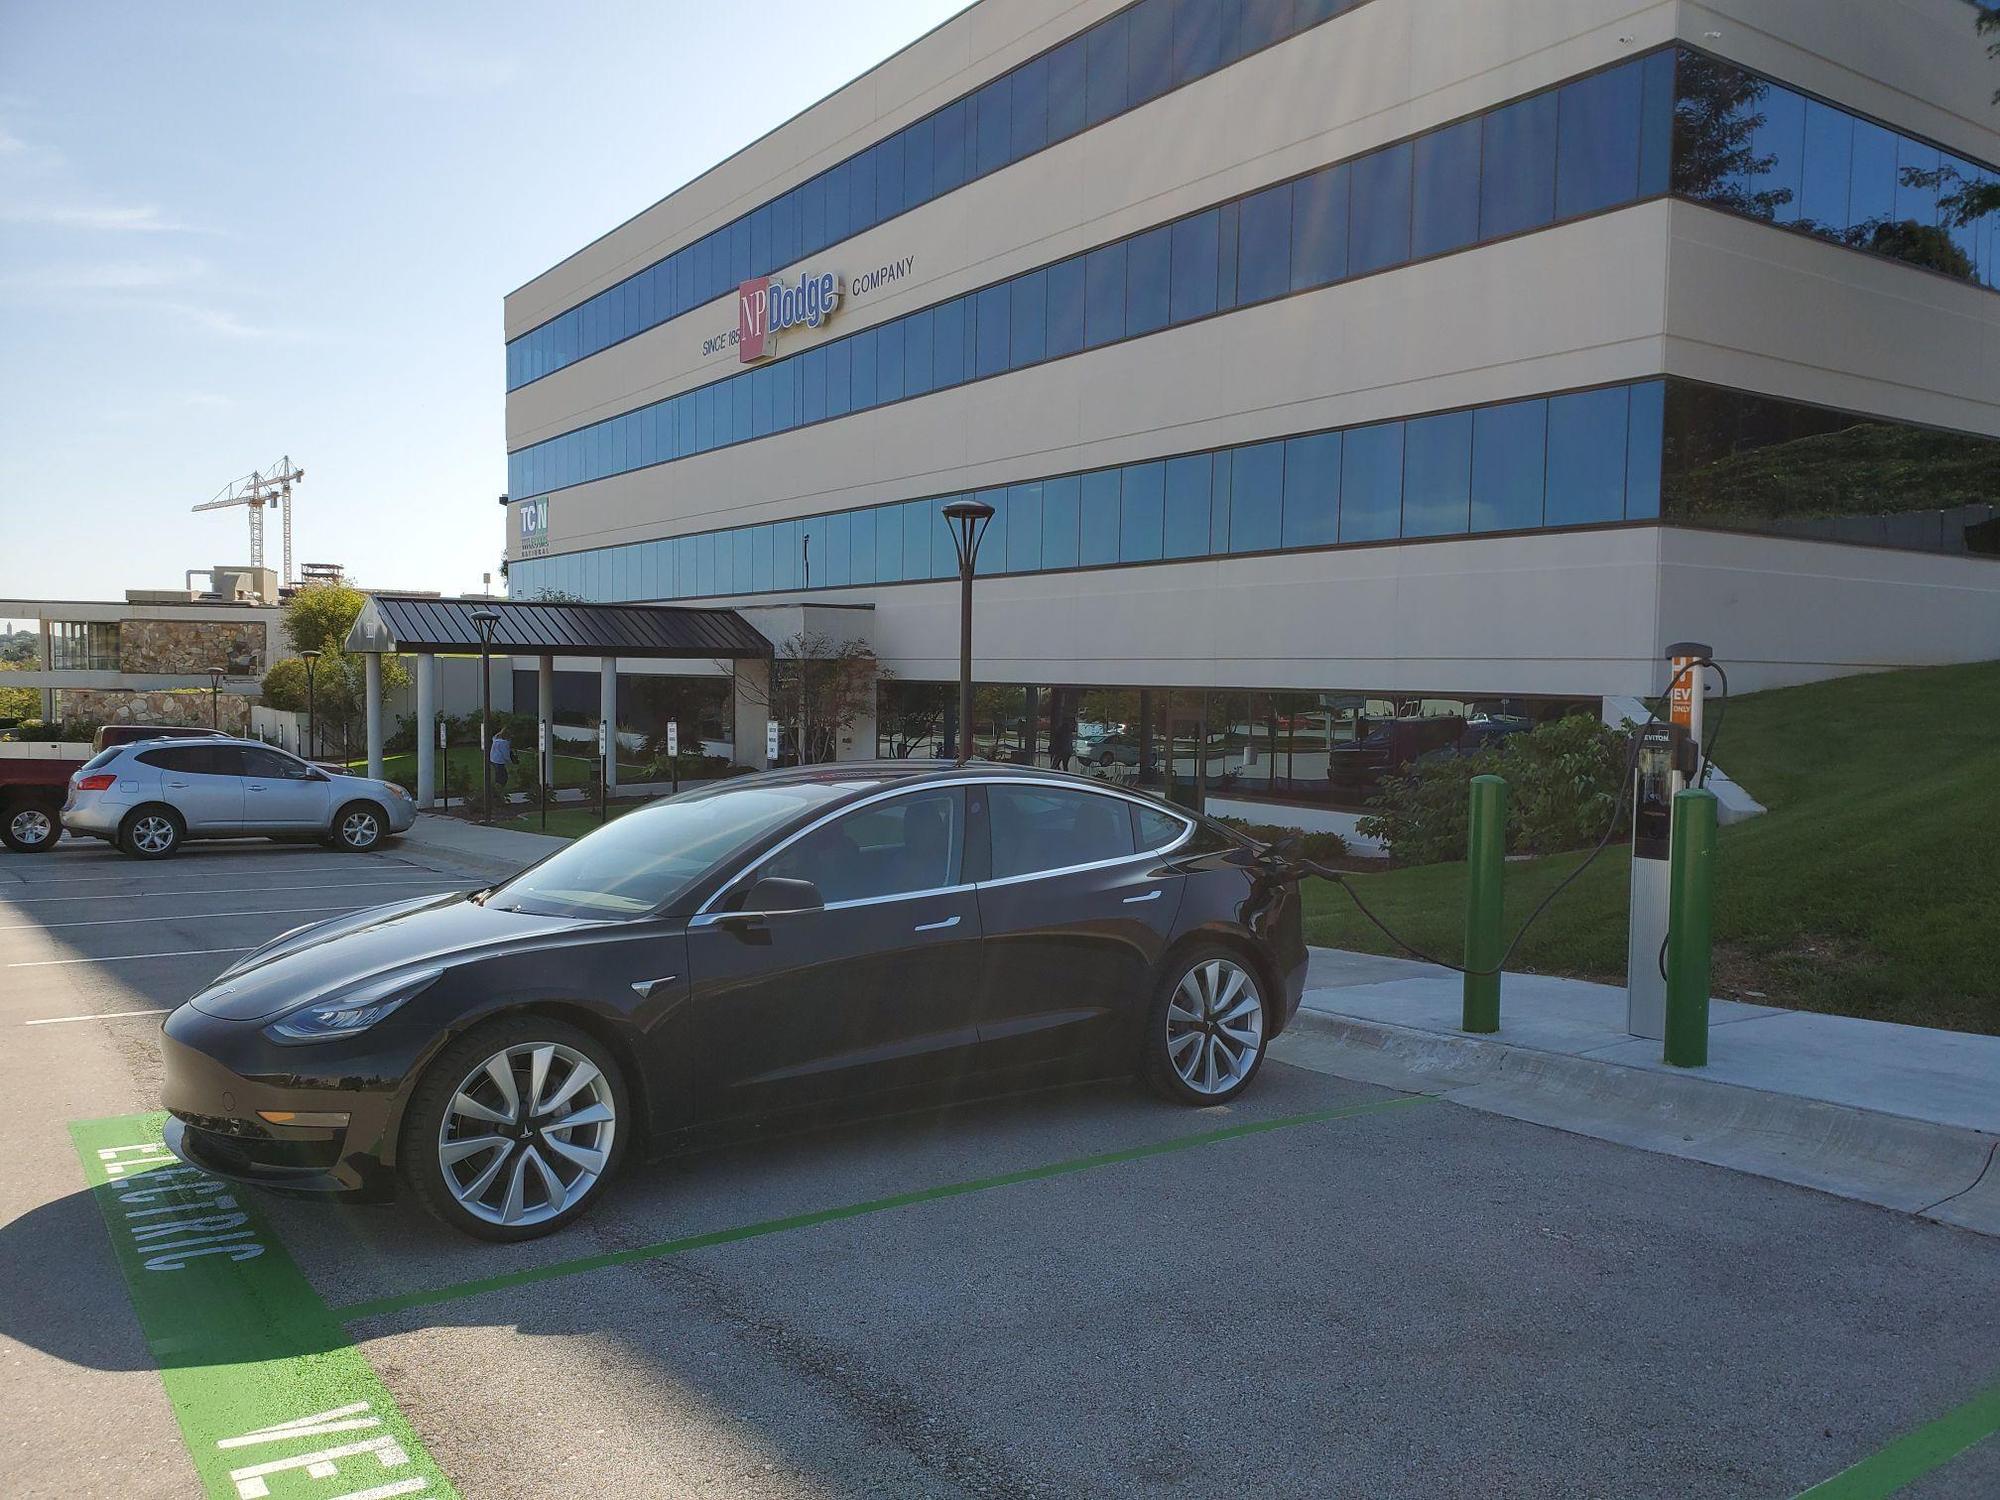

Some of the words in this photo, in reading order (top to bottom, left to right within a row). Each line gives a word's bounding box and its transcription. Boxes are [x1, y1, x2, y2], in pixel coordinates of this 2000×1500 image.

[702, 332, 727, 356] SINCE
[852, 255, 915, 297] COMPANY
[520, 504, 547, 532] TCN
[1673, 687, 1692, 700] EV
[1673, 704, 1691, 713] ONLY
[1643, 734, 1669, 742] EVITON
